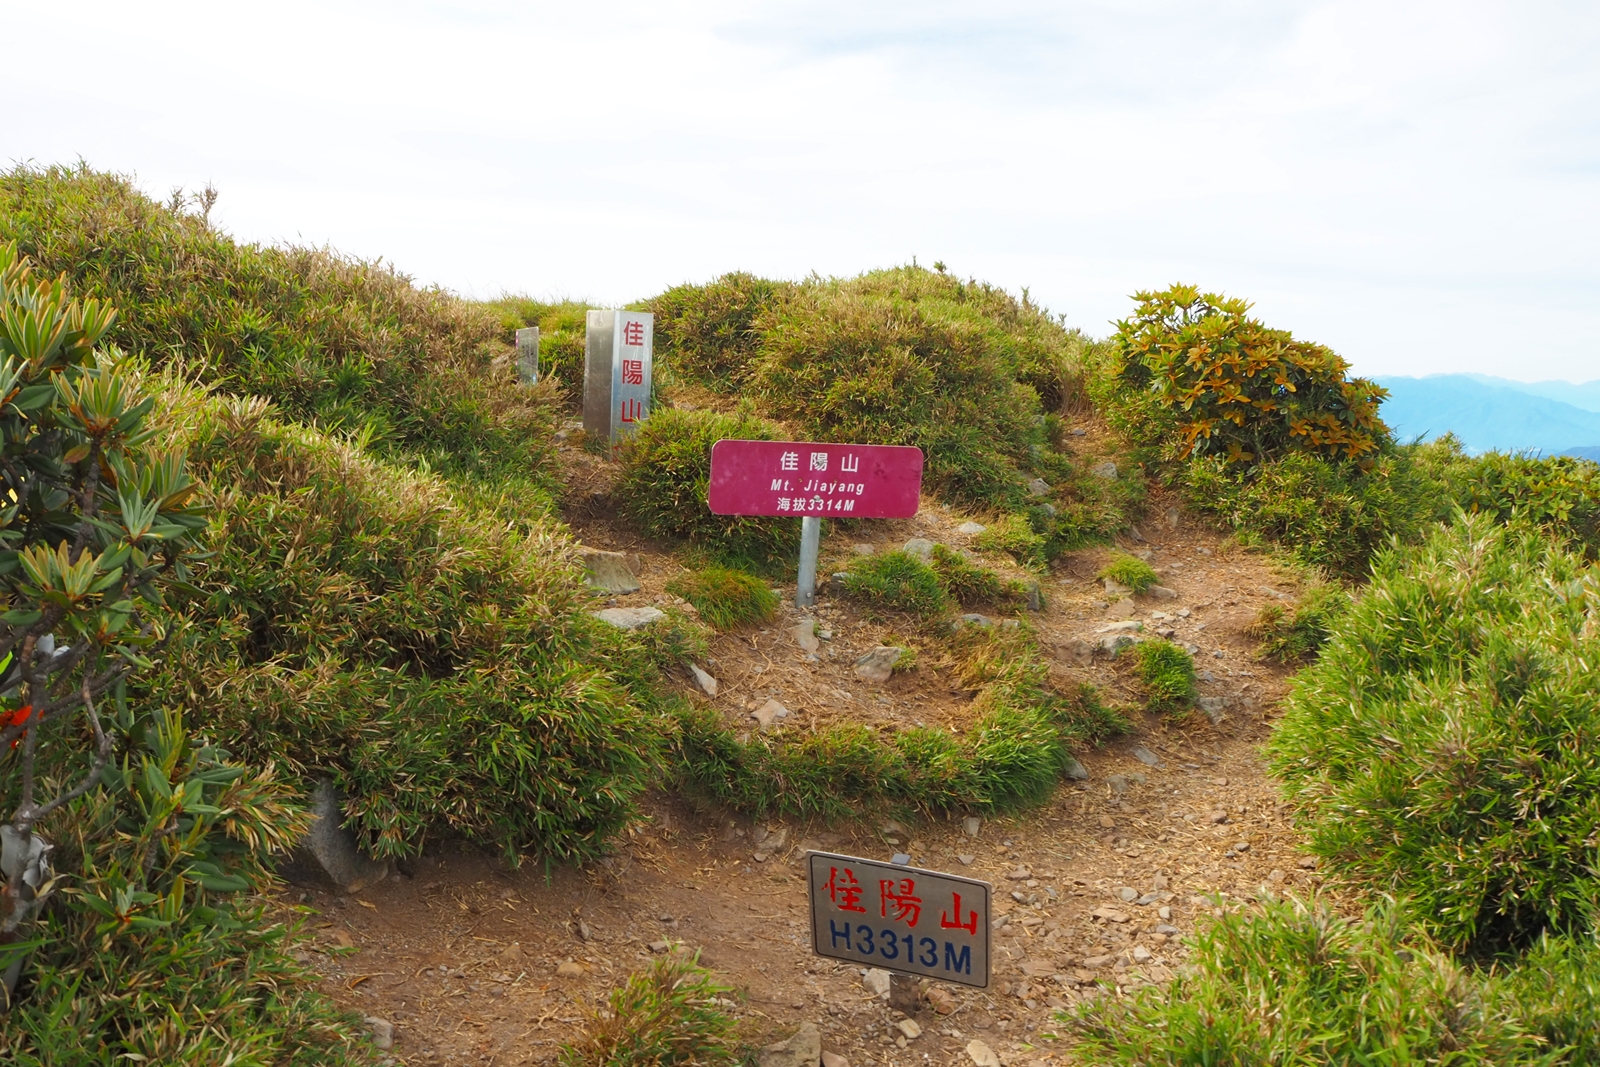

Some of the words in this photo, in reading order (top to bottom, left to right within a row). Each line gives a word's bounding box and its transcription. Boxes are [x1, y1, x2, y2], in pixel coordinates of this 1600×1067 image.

[621, 321, 644, 423] 佳陽山
[780, 451, 859, 473] 佳陽山
[770, 479, 794, 492] Mt.
[804, 479, 865, 495] Jiayang
[776, 497, 855, 512] 海拔3314M
[821, 866, 978, 936] 佳陽山
[830, 919, 971, 975] H3313M
